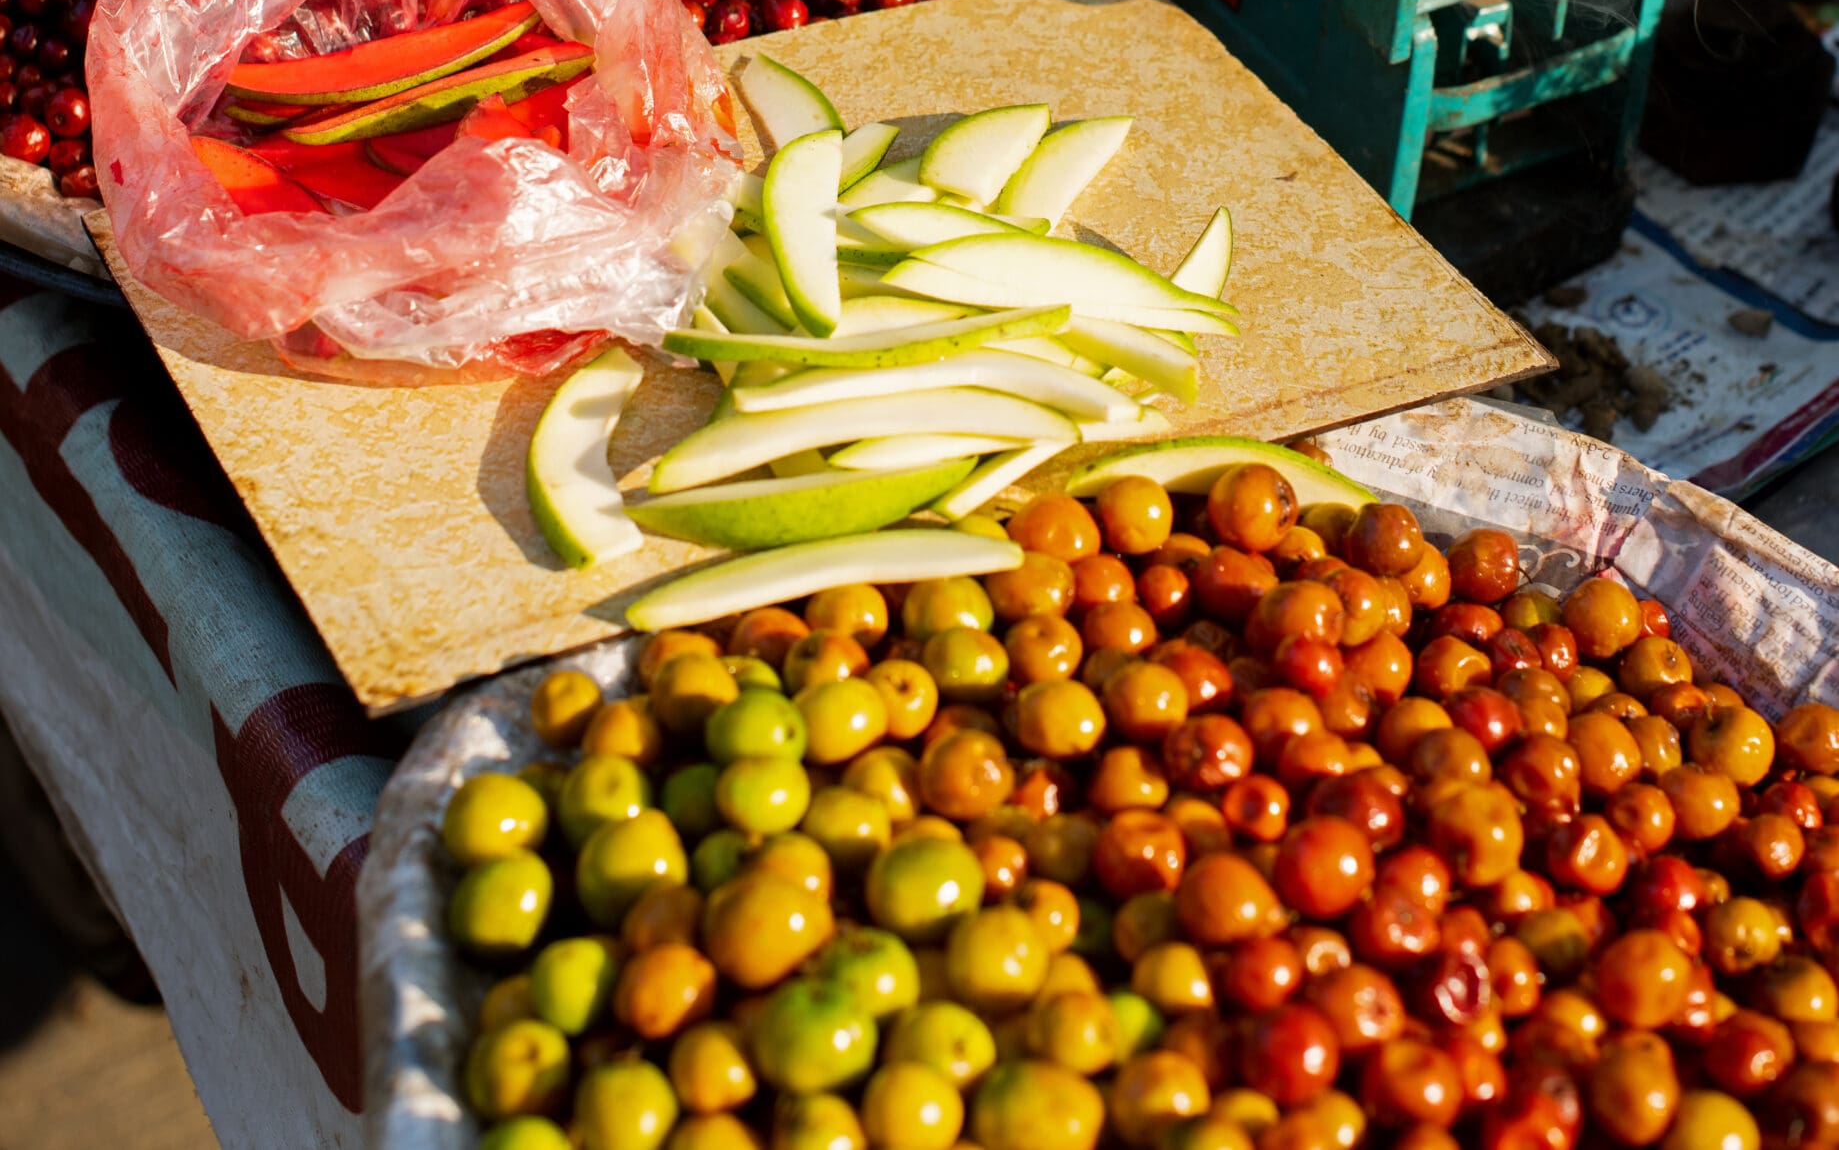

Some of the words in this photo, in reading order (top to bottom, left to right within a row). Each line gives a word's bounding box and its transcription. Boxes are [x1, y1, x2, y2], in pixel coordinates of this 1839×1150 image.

[1368, 424, 1387, 441] by
[1571, 434, 1610, 459] 2-day
[1504, 491, 1541, 512] affect
[1686, 590, 1725, 631] feeling
